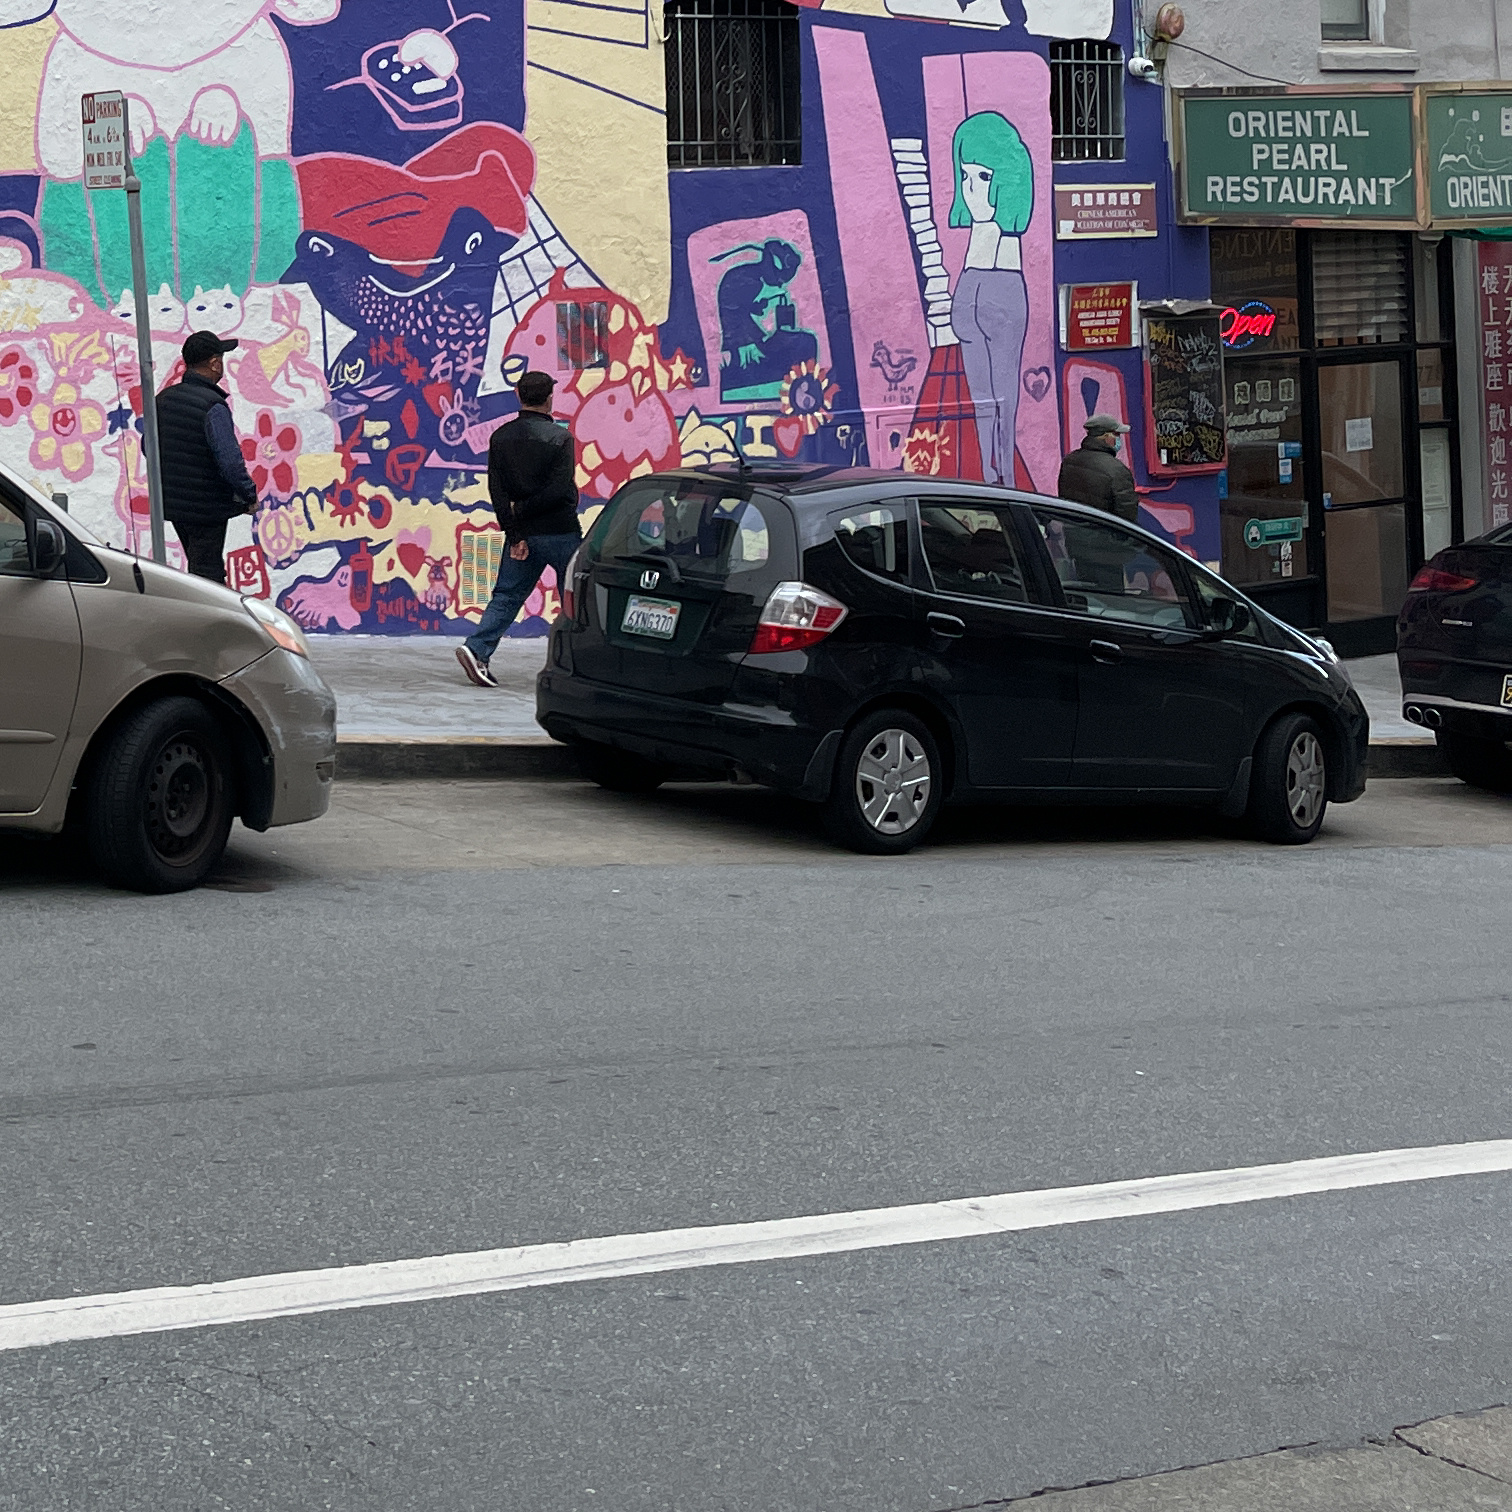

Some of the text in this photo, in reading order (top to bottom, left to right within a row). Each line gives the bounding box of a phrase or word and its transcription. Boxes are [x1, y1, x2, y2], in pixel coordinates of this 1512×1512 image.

[83, 97, 122, 121] NO PARKING
[1228, 110, 1369, 138] ORIENTAL
[1252, 143, 1348, 171] PEARL
[1207, 176, 1396, 205] RESTAURANT
[1220, 308, 1276, 344] Open
[1482, 266, 1503, 391] 楼上雅座
